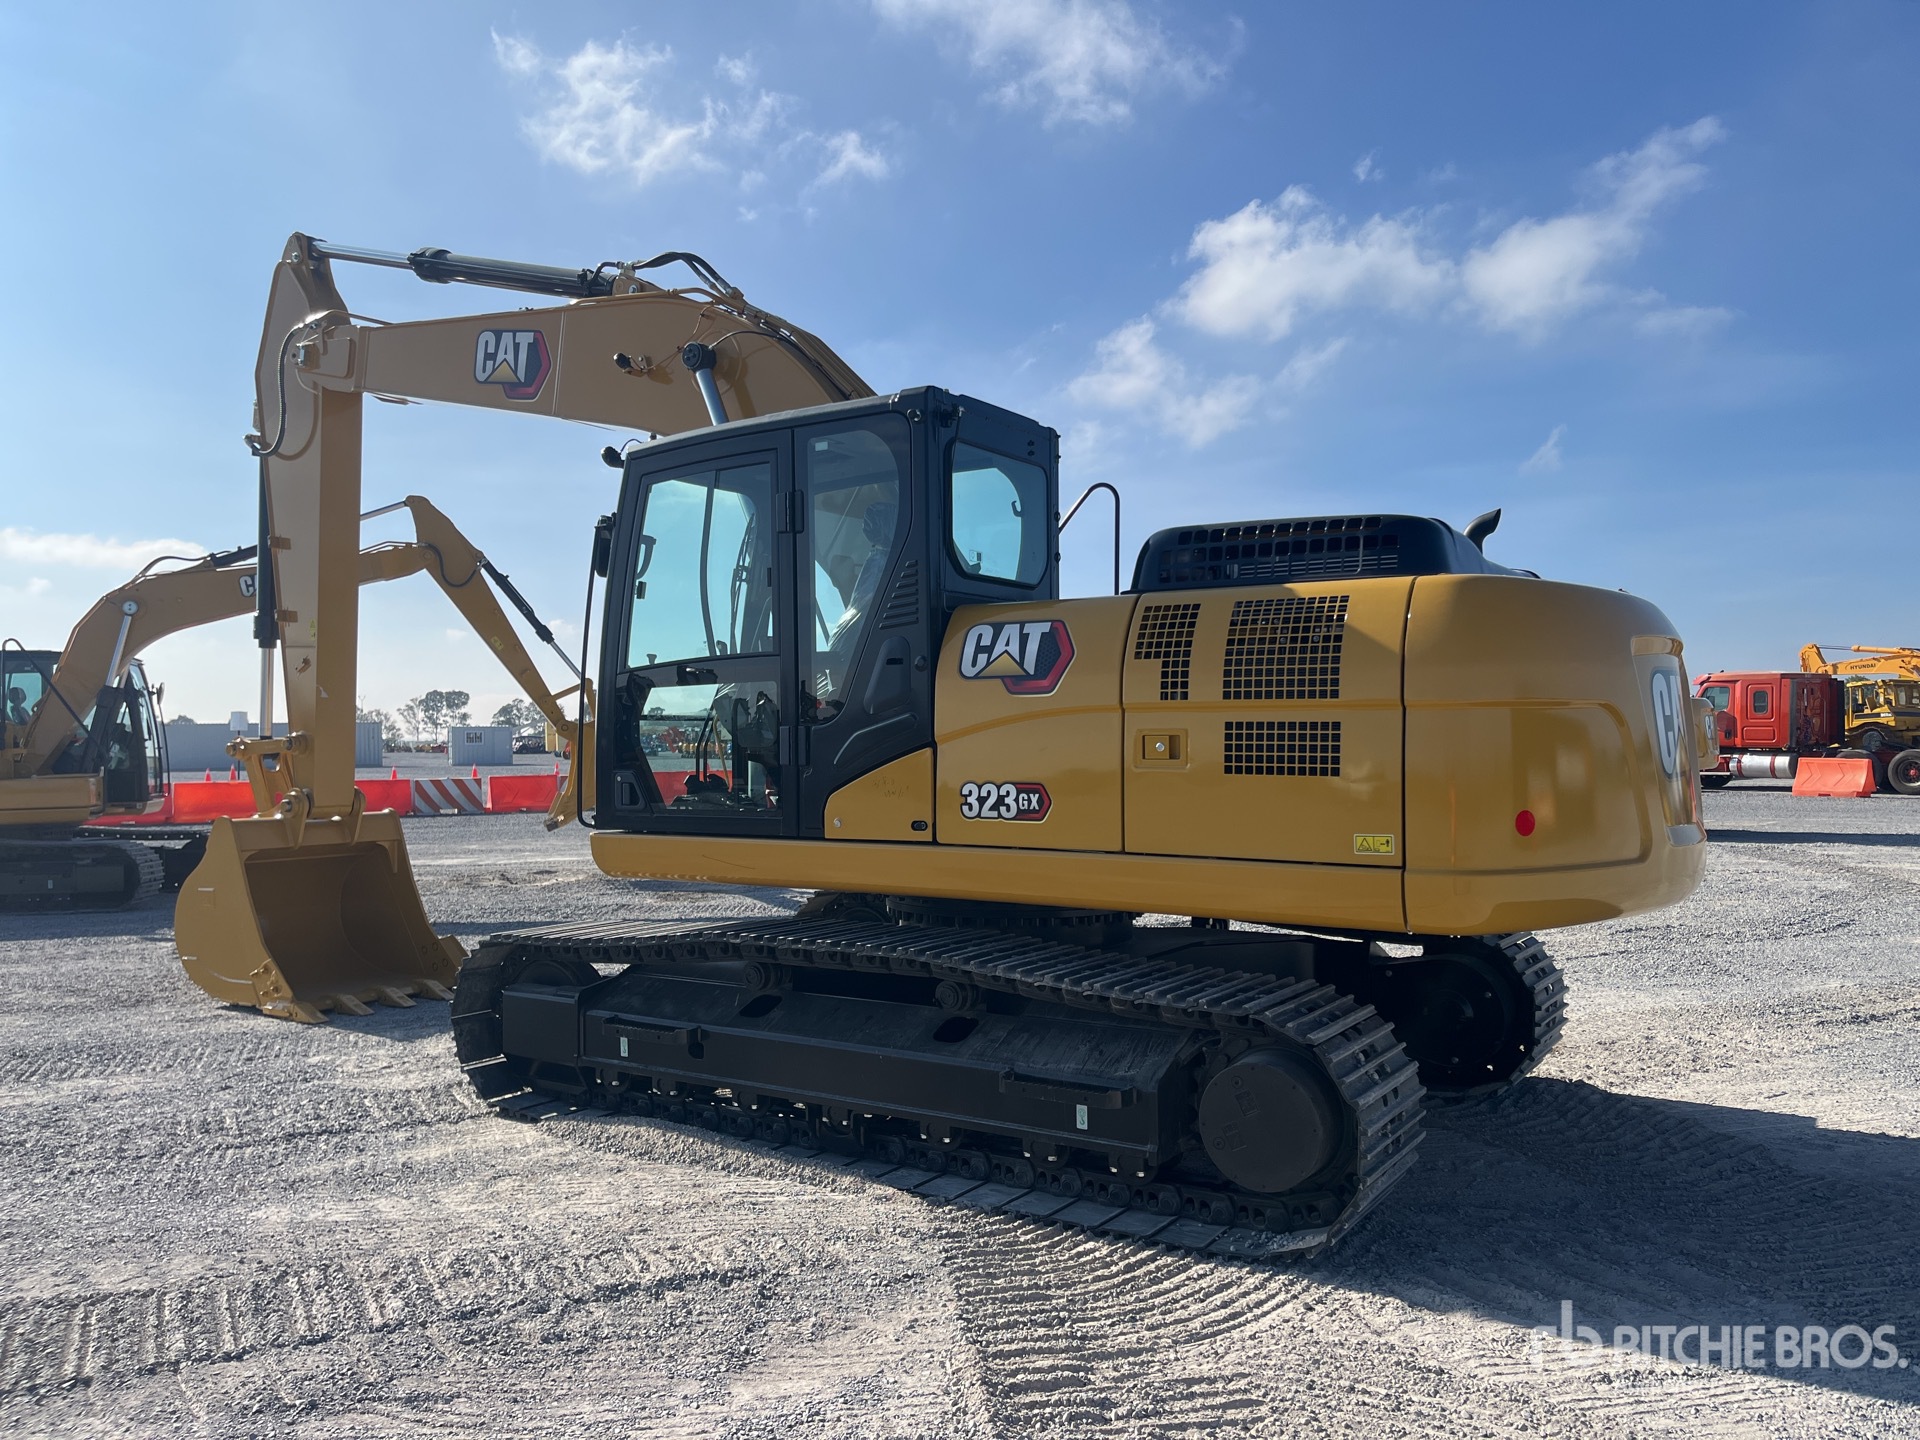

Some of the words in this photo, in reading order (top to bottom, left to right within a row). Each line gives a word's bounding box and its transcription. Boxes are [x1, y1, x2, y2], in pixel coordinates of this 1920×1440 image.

[475, 331, 534, 383] CAT
[960, 621, 1052, 677] CAT
[1652, 673, 1687, 774] CA
